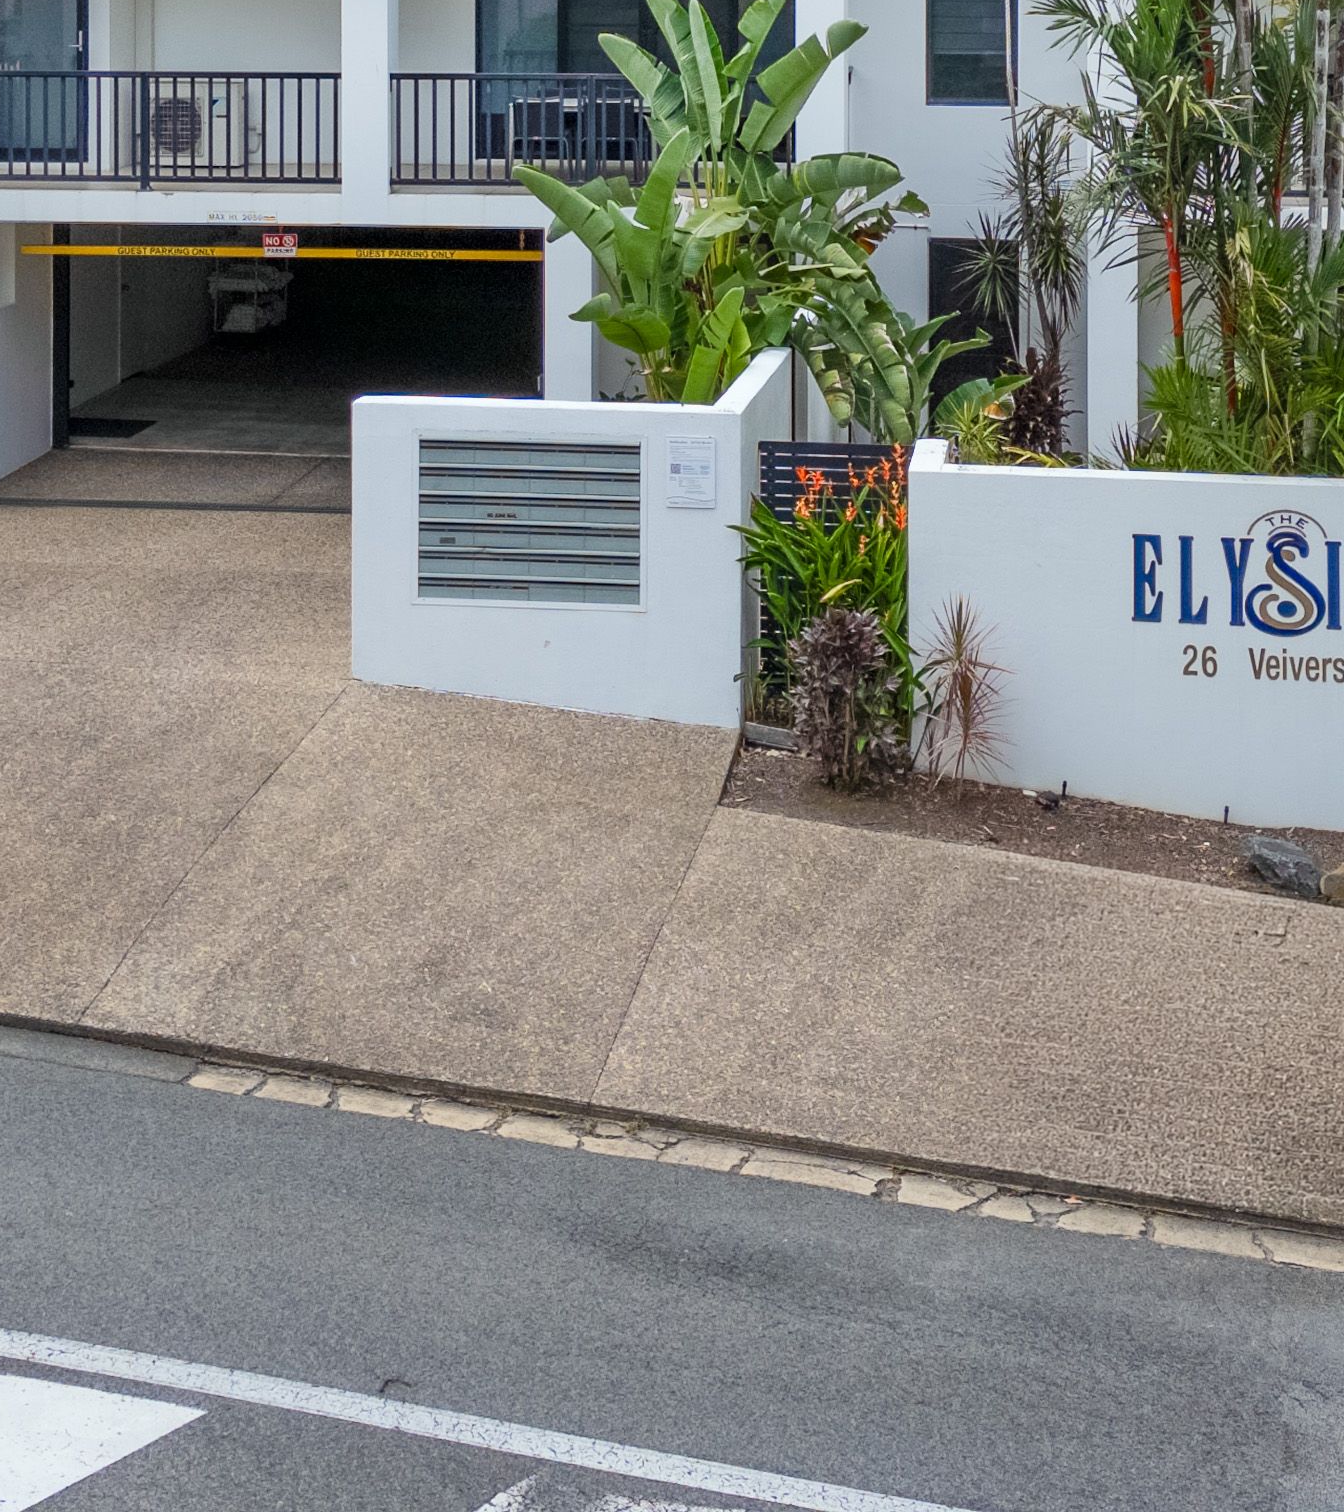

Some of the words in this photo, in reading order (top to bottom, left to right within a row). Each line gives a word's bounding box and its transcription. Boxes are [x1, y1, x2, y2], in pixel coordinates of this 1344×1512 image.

[265, 236, 280, 246] NO
[117, 247, 147, 255] GUEST
[149, 247, 190, 256] PARKING
[192, 248, 216, 256] ONLY
[356, 249, 387, 258] GUEST
[388, 249, 429, 258] PARKING
[431, 250, 456, 259] ONLY
[1264, 514, 1310, 530] THE
[1182, 645, 1218, 677] 26
